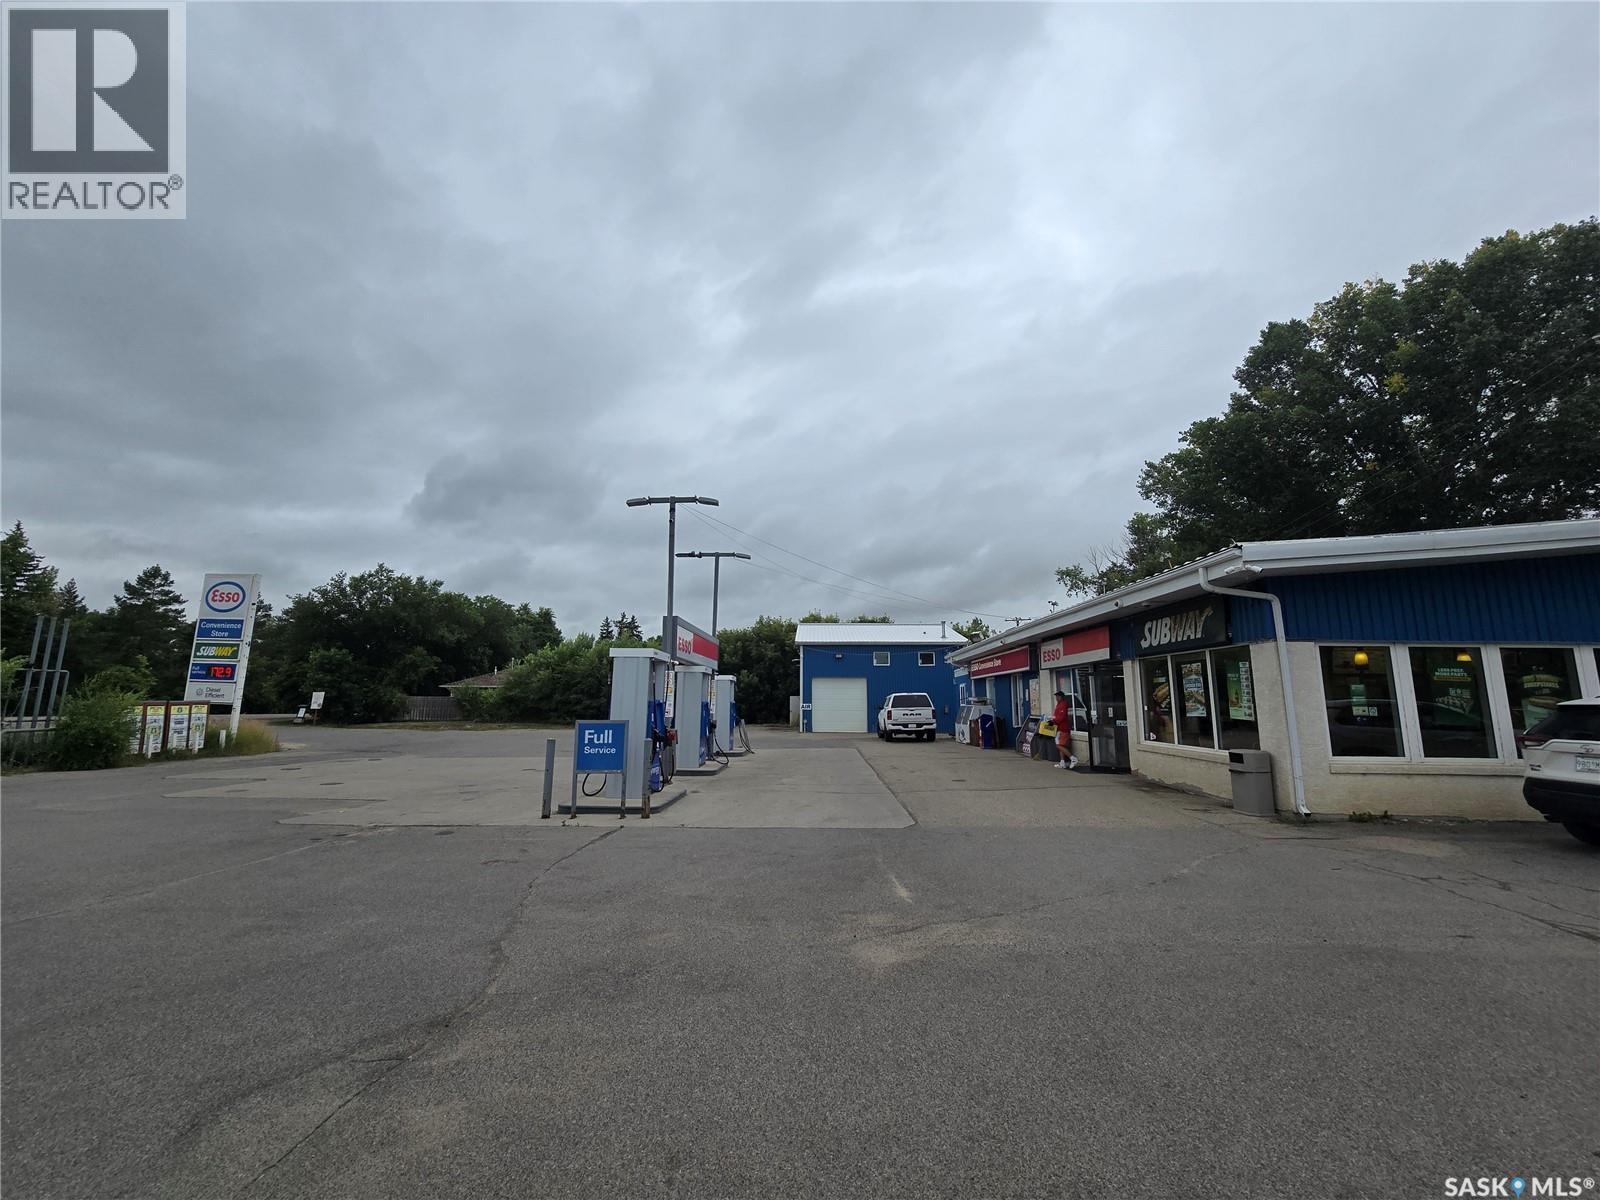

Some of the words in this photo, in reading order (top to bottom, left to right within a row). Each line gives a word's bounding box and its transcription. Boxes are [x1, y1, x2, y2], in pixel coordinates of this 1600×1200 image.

[200, 621, 242, 629] Convenience
[1140, 606, 1213, 649] SUBWAY
[210, 629, 229, 637] Store
[196, 646, 237, 656] SUBWAY
[677, 637, 692, 655] ESSO
[1043, 648, 1061, 663] ESSO
[584, 730, 613, 744] Full
[584, 746, 616, 755] Service
